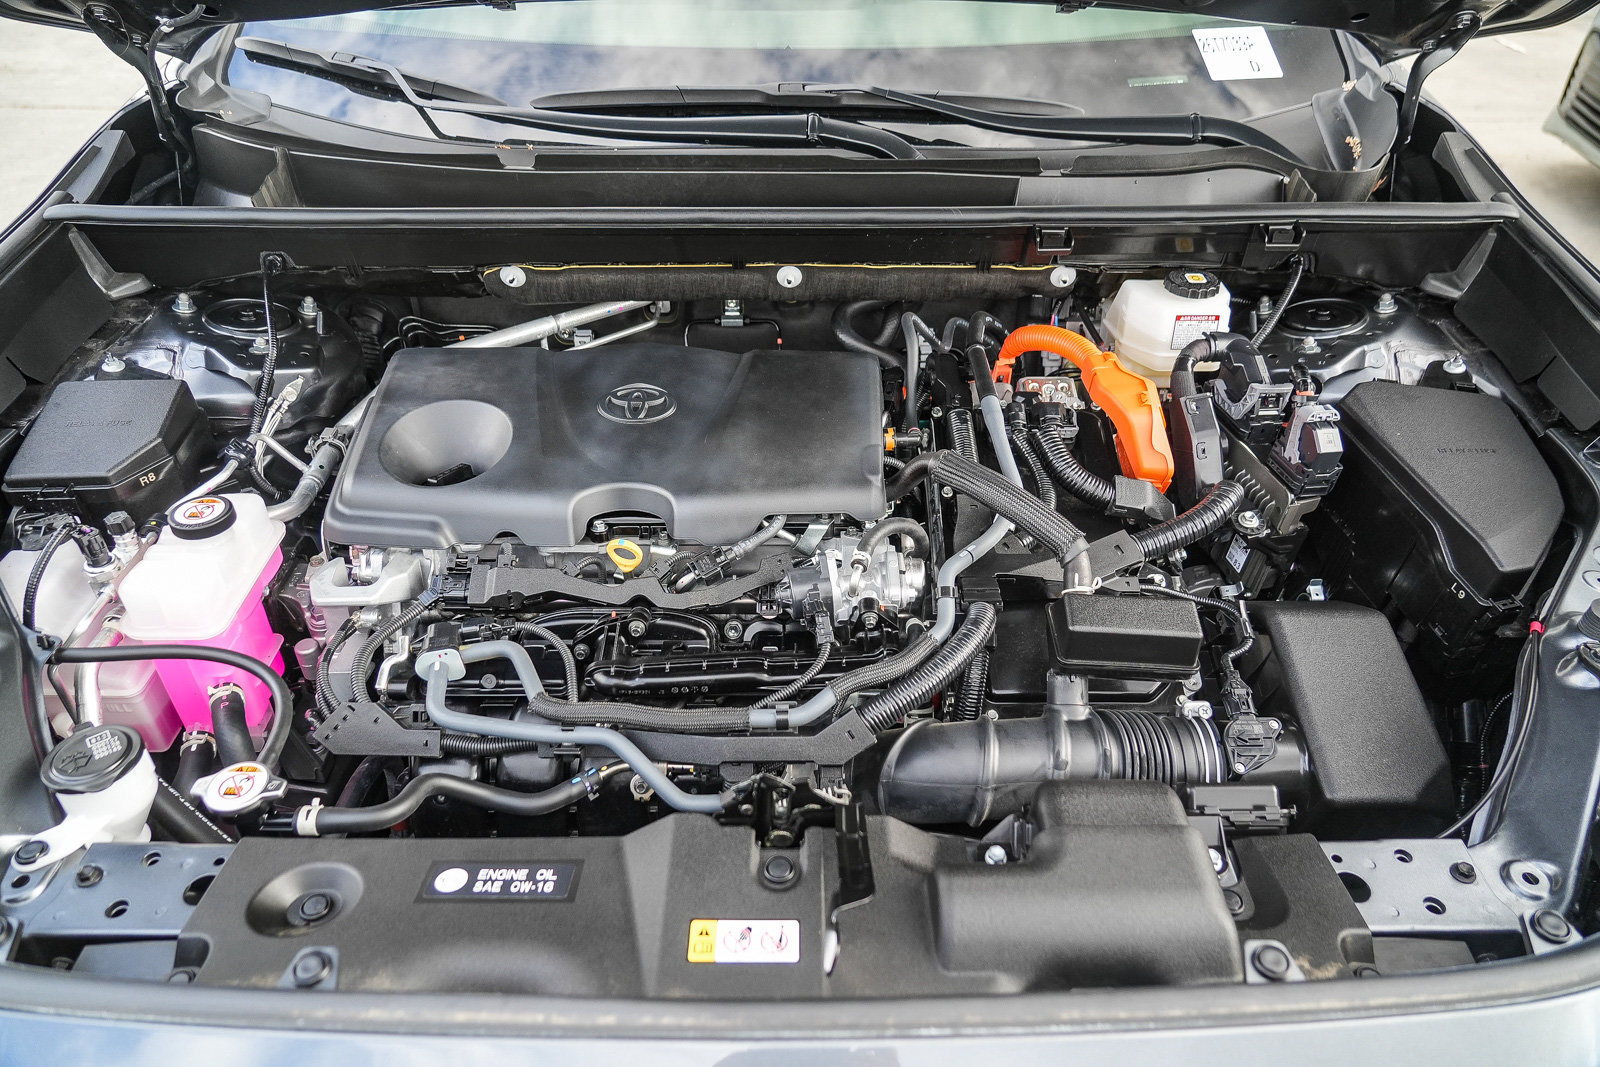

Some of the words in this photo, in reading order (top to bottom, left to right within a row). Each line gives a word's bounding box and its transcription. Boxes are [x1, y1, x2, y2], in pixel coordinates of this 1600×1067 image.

[139, 472, 157, 487] R8
[477, 868, 530, 881] ENGINE
[535, 868, 558, 881] OIL
[472, 881, 504, 893] SAE
